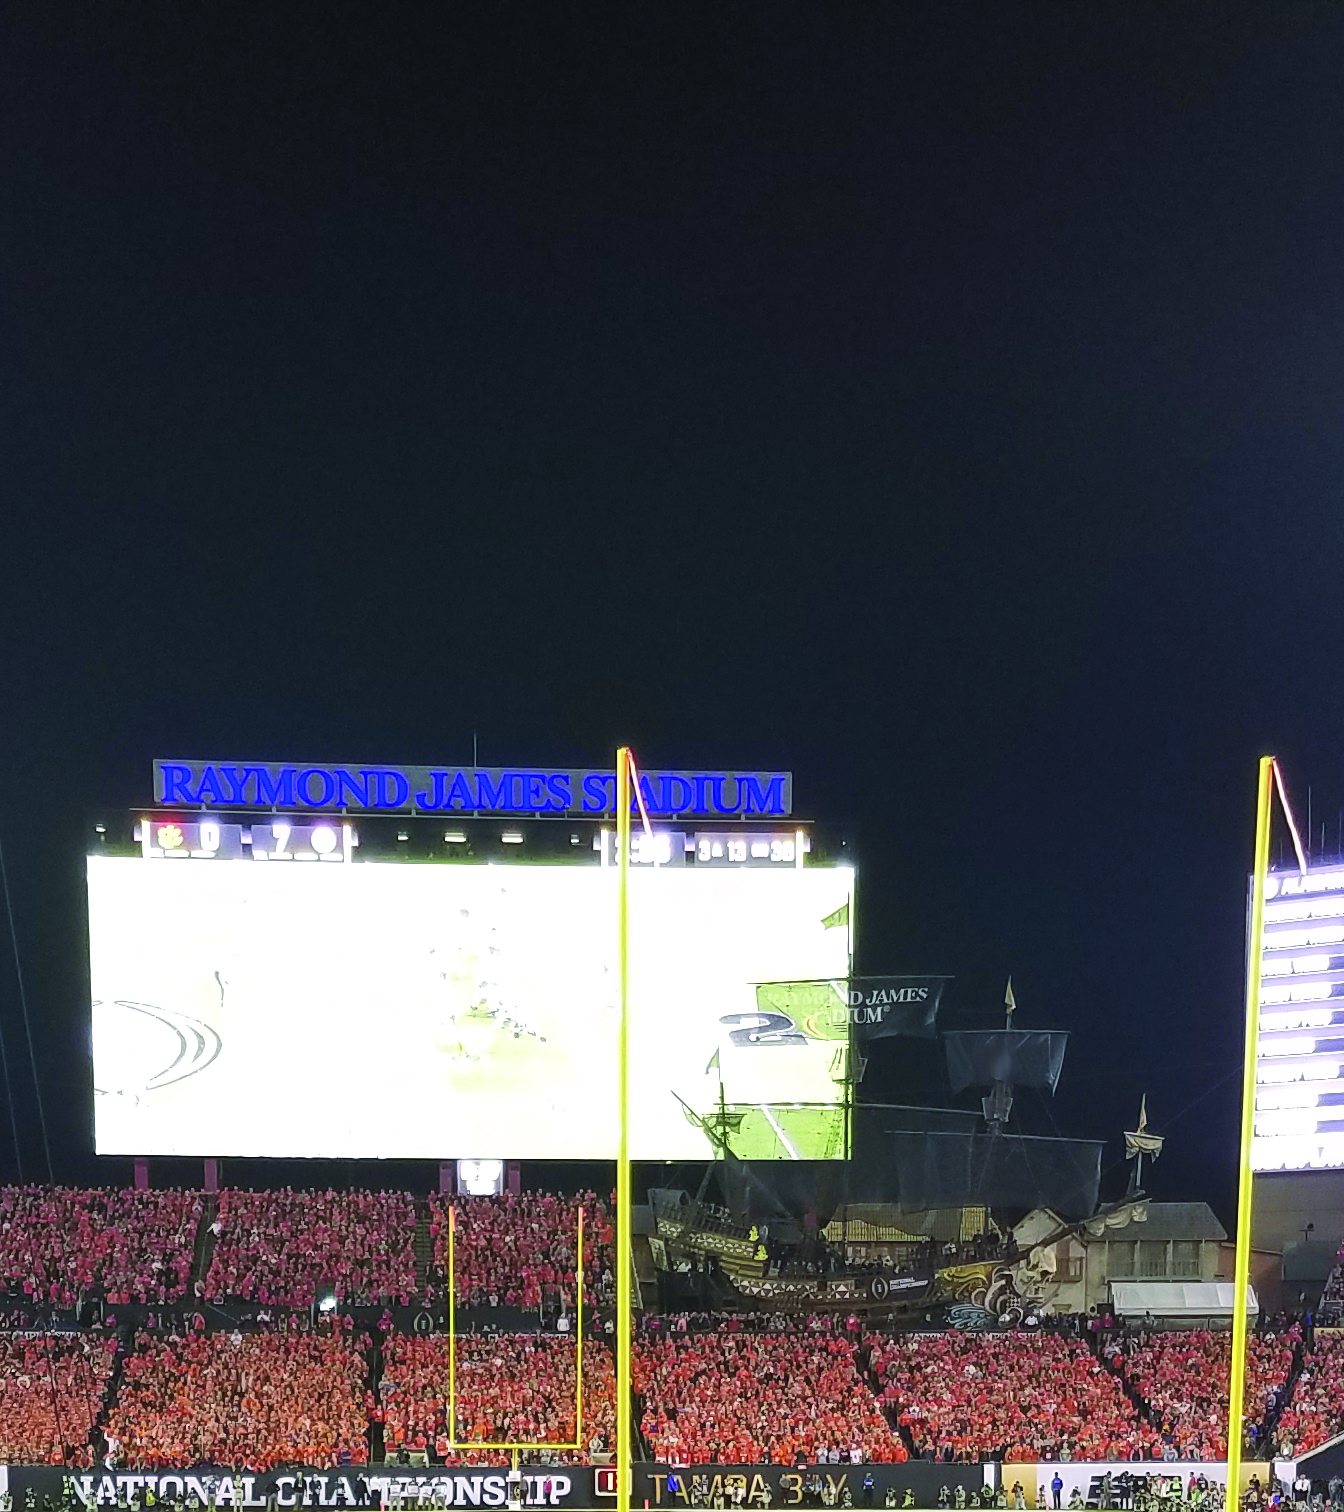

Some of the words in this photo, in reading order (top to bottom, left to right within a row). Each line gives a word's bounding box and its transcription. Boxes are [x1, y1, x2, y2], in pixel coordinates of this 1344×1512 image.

[161, 766, 409, 808] RAYMOND
[416, 772, 571, 813] JAMES
[865, 987, 929, 1006] JAMES
